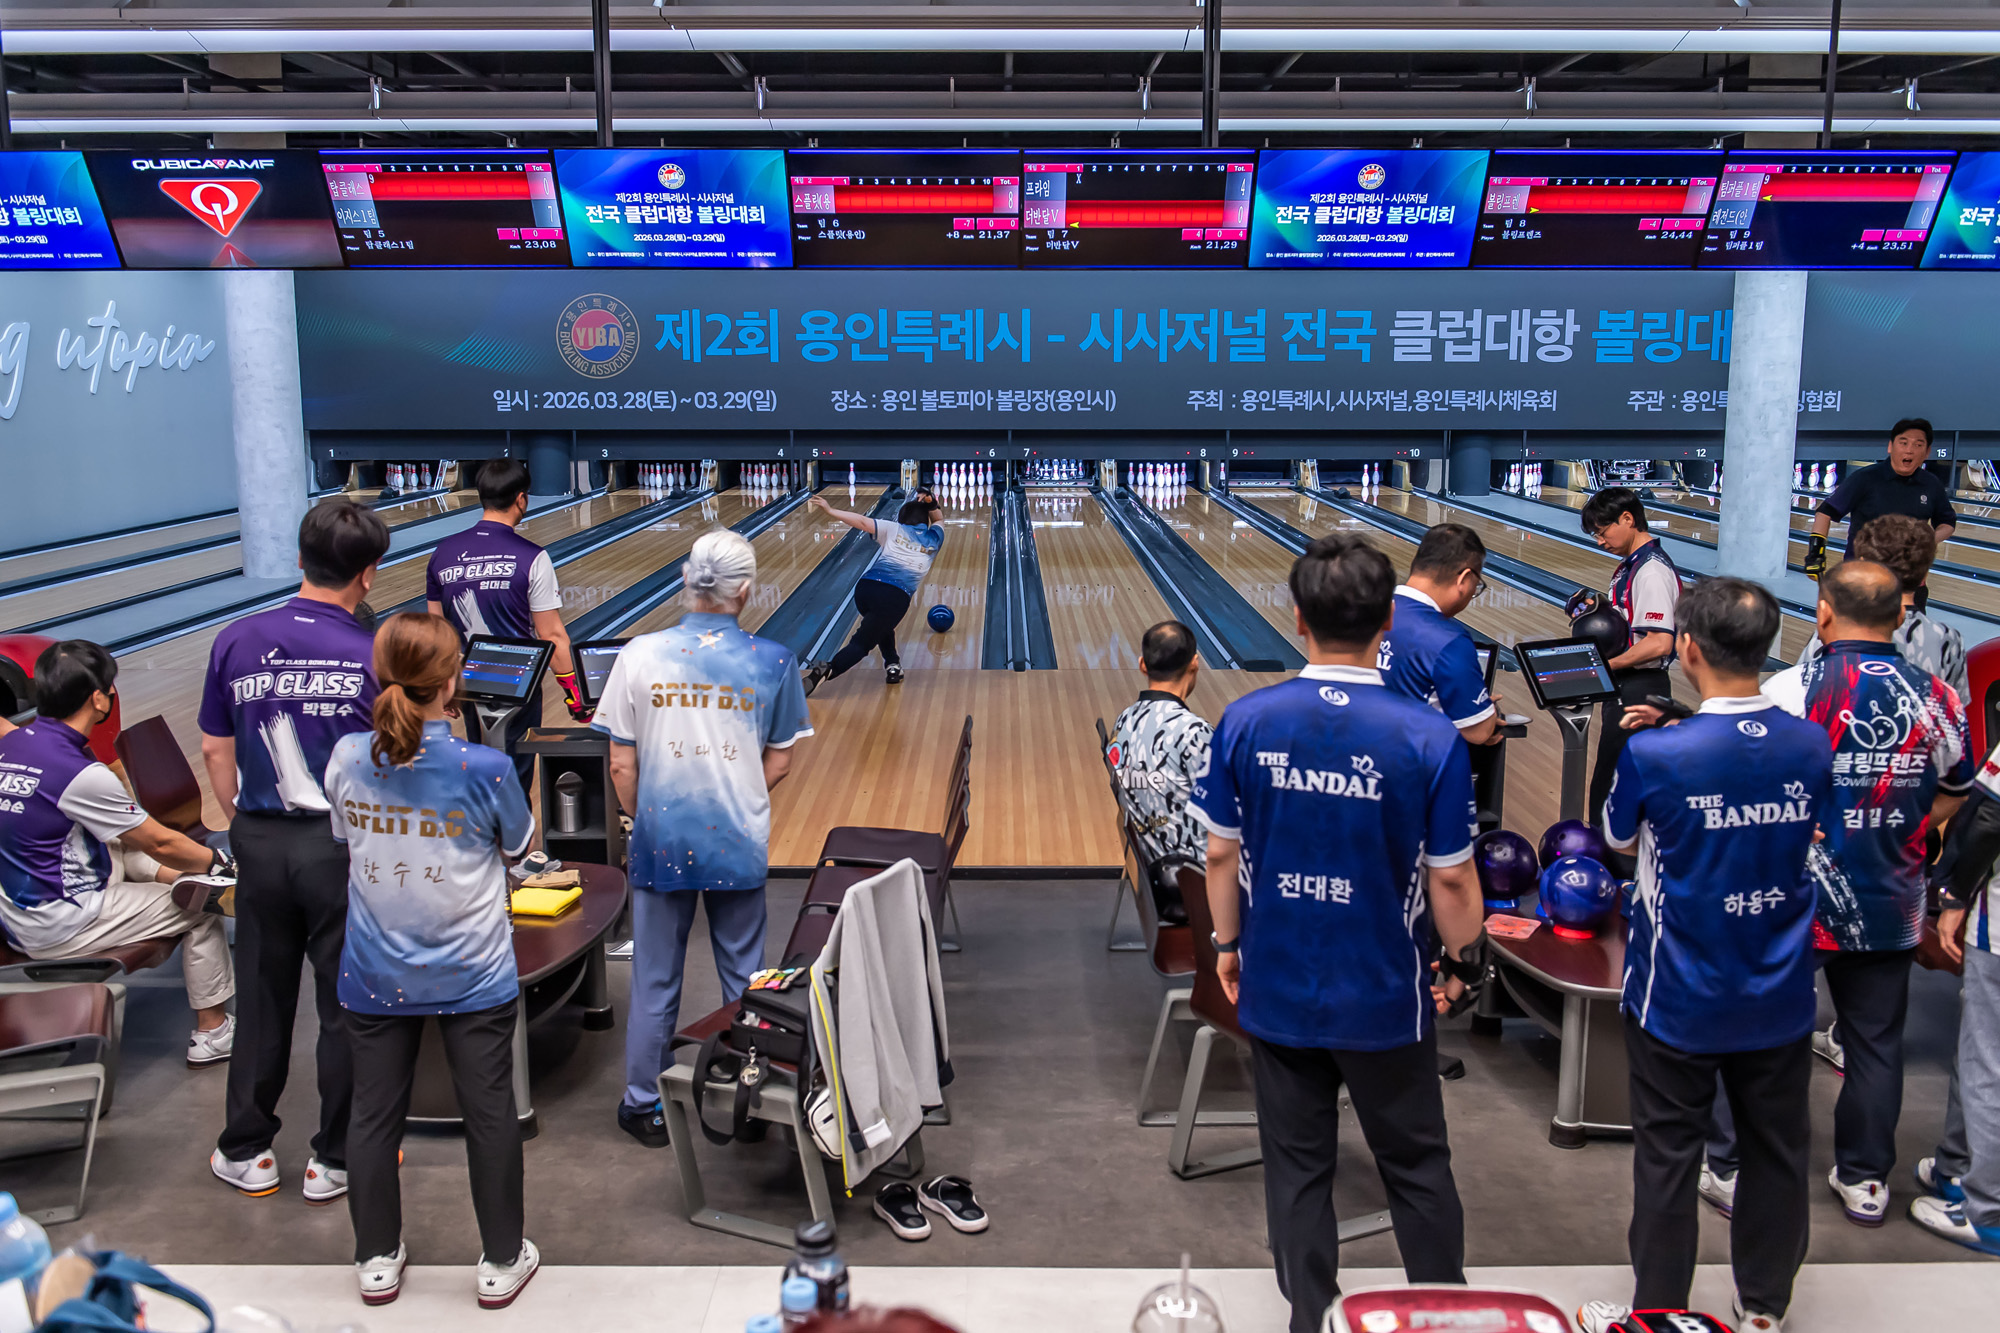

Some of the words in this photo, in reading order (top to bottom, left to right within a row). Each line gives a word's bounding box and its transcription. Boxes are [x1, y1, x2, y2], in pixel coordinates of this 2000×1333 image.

[1076, 173, 1082, 184] X
[1026, 180, 1050, 197] 프라임
[10, 195, 47, 206] 시사저널
[615, 193, 642, 204] 제2회
[643, 193, 690, 204] 용인특례시
[697, 193, 735, 204] 시사저널
[1310, 193, 1336, 204] 제2회
[1337, 193, 1385, 204] 용인특례시
[1391, 193, 1429, 204] 시사저널
[13, 207, 83, 226] 볼링대회
[585, 205, 621, 224] 전국
[624, 205, 693, 224] 클럽대항
[696, 205, 766, 224] 볼링대회
[1275, 206, 1311, 224] 전국
[1314, 206, 1382, 224] 클럽대항
[1386, 206, 1456, 224] 볼링대회
[1960, 207, 1995, 226] 전국
[832, 219, 840, 227] 6
[1519, 219, 1526, 227] 8
[946, 231, 960, 239] +8
[1061, 230, 1069, 238] 7
[575, 327, 620, 347] YIBA
[655, 308, 780, 363] 제2회
[795, 308, 1031, 363] 용인특례시
[1078, 308, 1267, 363] 시사저널
[1281, 308, 1377, 363] 전국
[1389, 308, 1581, 363] 클럽대항
[1591, 309, 1734, 363] 볼링대
[560, 331, 589, 372] BOWLING
[589, 331, 636, 376] ASSOCIATION
[493, 390, 530, 412] 일시
[831, 390, 868, 412] 장소
[880, 390, 917, 412] 용인
[920, 390, 994, 412] 볼토피아
[995, 390, 1117, 412] 볼링장(용인시)
[1186, 390, 1224, 412] 주최
[1627, 390, 1665, 412] 주관
[1680, 390, 1729, 412] 용인특
[329, 449, 334, 458] 1
[601, 449, 609, 458] 3
[777, 449, 785, 458] 4
[811, 449, 819, 458] 5
[989, 449, 996, 458] 6
[1023, 448, 1030, 457] 7
[1200, 448, 1207, 458] 8
[1232, 448, 1239, 458] 9
[1409, 449, 1420, 458] 10
[1695, 449, 1707, 458] 12
[1936, 448, 1947, 458] 15
[438, 566, 465, 585] TOP
[465, 562, 517, 580] CLASS
[230, 672, 274, 705] TOP
[275, 671, 364, 699] CLASS
[651, 683, 713, 708] SPLIT
[302, 702, 354, 717] 박명수
[1256, 752, 1290, 767] THE
[1832, 752, 1929, 775] 볼링프렌즈
[0, 772, 41, 798] ASS
[1269, 766, 1383, 801] BANDAL
[1686, 795, 1724, 810] THE
[344, 799, 413, 835] SPLIT
[1703, 800, 1811, 830] BANDAL
[1276, 872, 1354, 904] 전대환
[1723, 886, 1786, 917] 하용수
